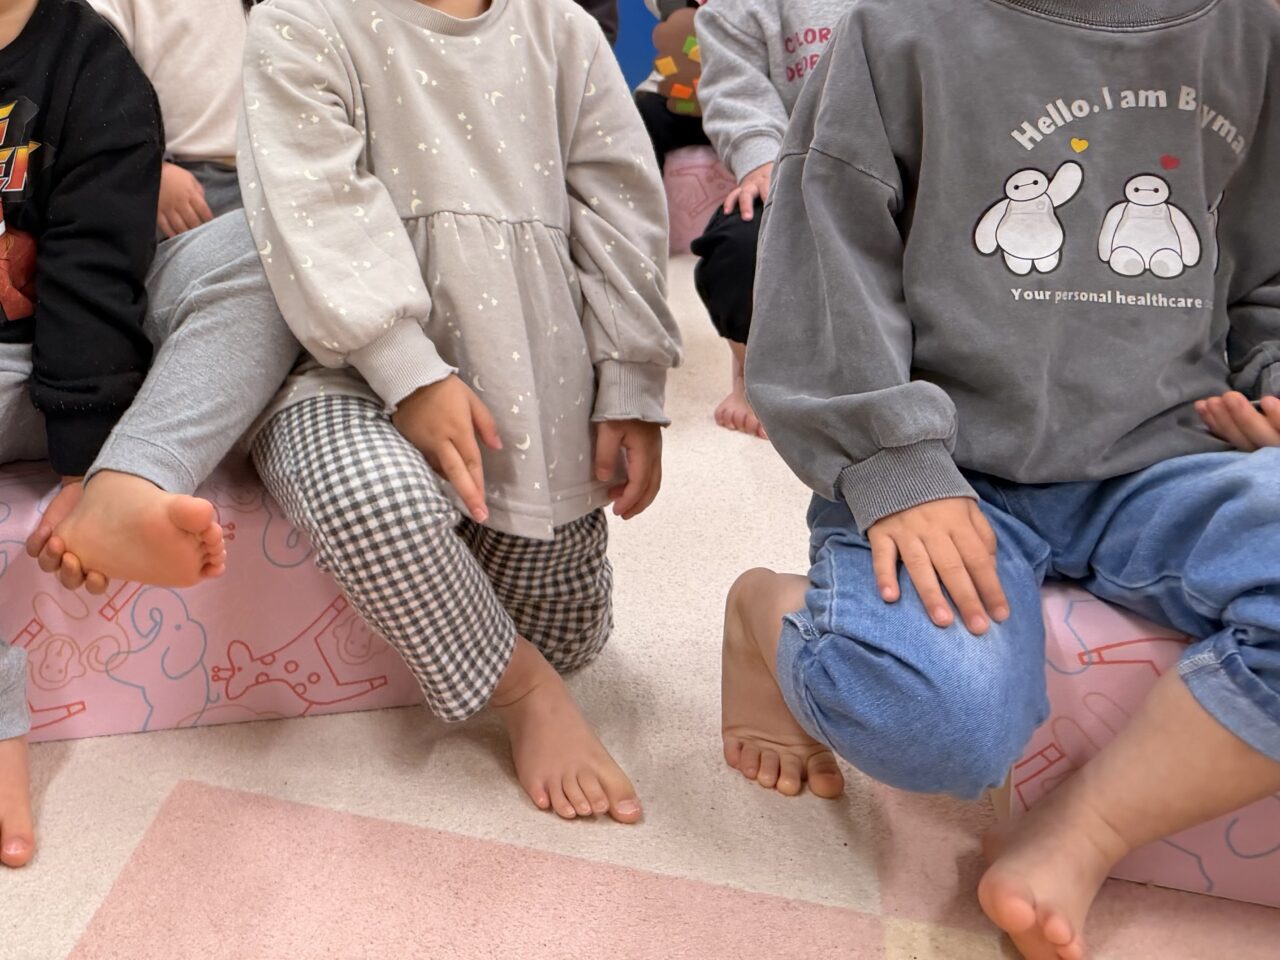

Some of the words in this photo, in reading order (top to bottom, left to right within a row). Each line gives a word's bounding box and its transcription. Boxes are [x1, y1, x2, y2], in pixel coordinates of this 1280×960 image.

[1102, 86, 1113, 110] I
[1120, 89, 1168, 108] am
[1010, 288, 1052, 301] Your
[1054, 290, 1112, 304] personal
[1115, 290, 1203, 309] healthcare
